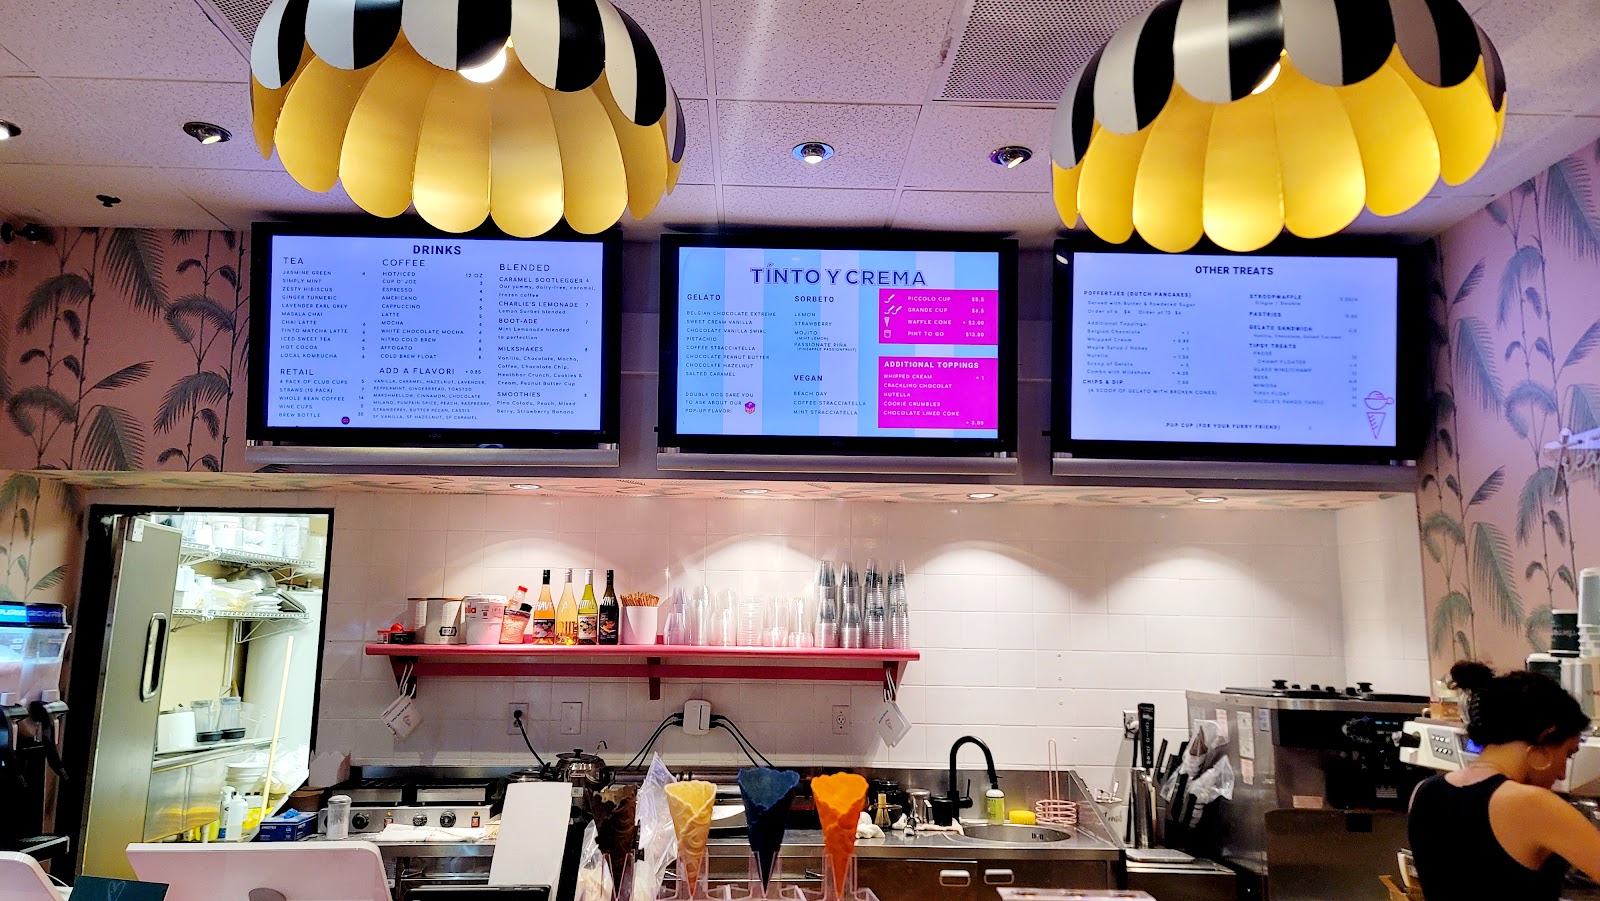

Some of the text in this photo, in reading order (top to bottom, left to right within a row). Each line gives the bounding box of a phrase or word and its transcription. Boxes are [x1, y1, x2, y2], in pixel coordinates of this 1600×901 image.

[413, 245, 462, 255] DRINKS
[283, 257, 304, 265] TEA
[382, 259, 426, 267] COFFEE
[499, 263, 550, 272] BLENDED
[1195, 265, 1274, 276] OTHER TREATS
[825, 268, 842, 285] Y
[846, 269, 928, 286] CREMA
[937, 361, 979, 369] TOPPINGS
[280, 368, 314, 376] RETAIL
[793, 374, 823, 382] VEGAN
